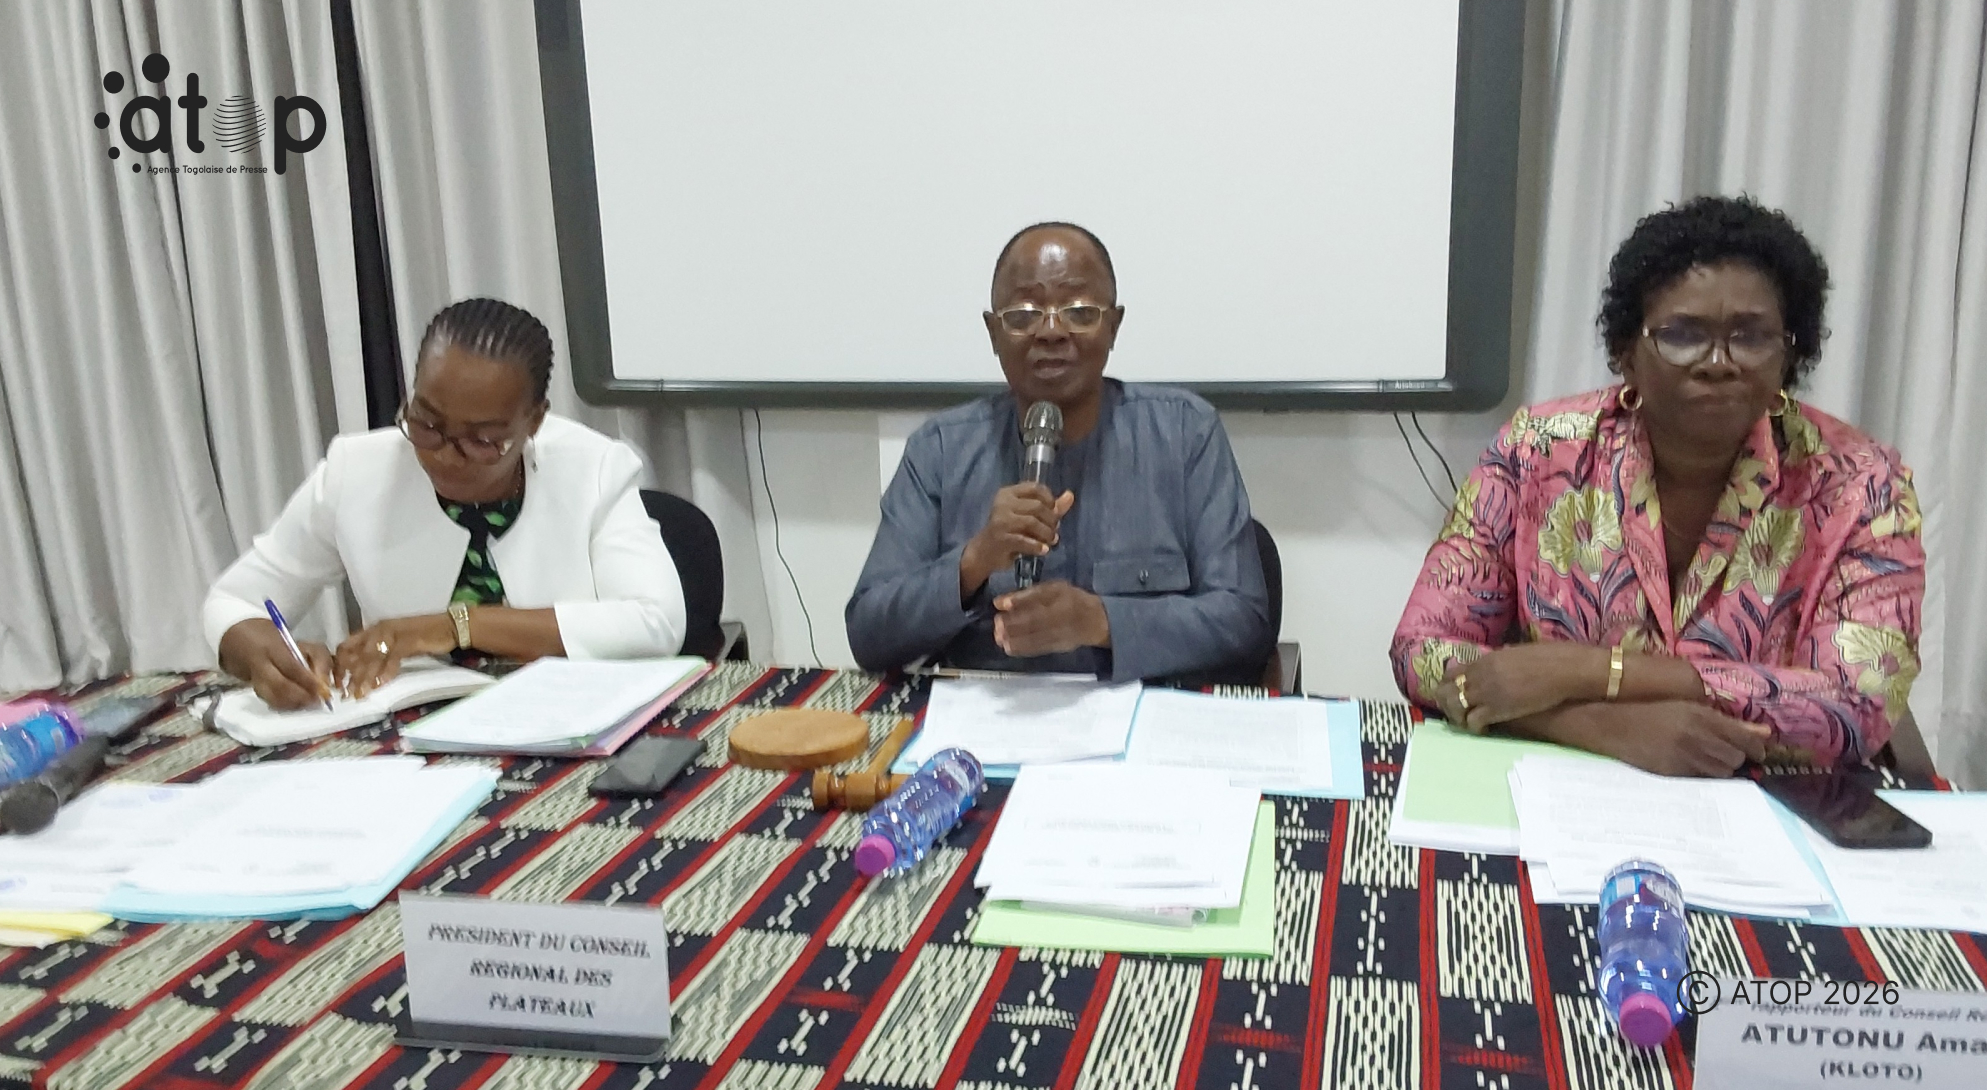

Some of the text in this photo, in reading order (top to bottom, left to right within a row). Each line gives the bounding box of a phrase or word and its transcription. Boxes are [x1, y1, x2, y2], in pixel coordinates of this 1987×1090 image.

[428, 923, 651, 958] PRESIDENT DU CONSEIL
[574, 967, 613, 987] DES
[489, 992, 596, 1018] PLATEAUX
[1889, 1005, 1961, 1020] Conseil
[1741, 1022, 1905, 1050] ATUTONU
[1820, 1061, 1922, 1082] (KLOTO)
